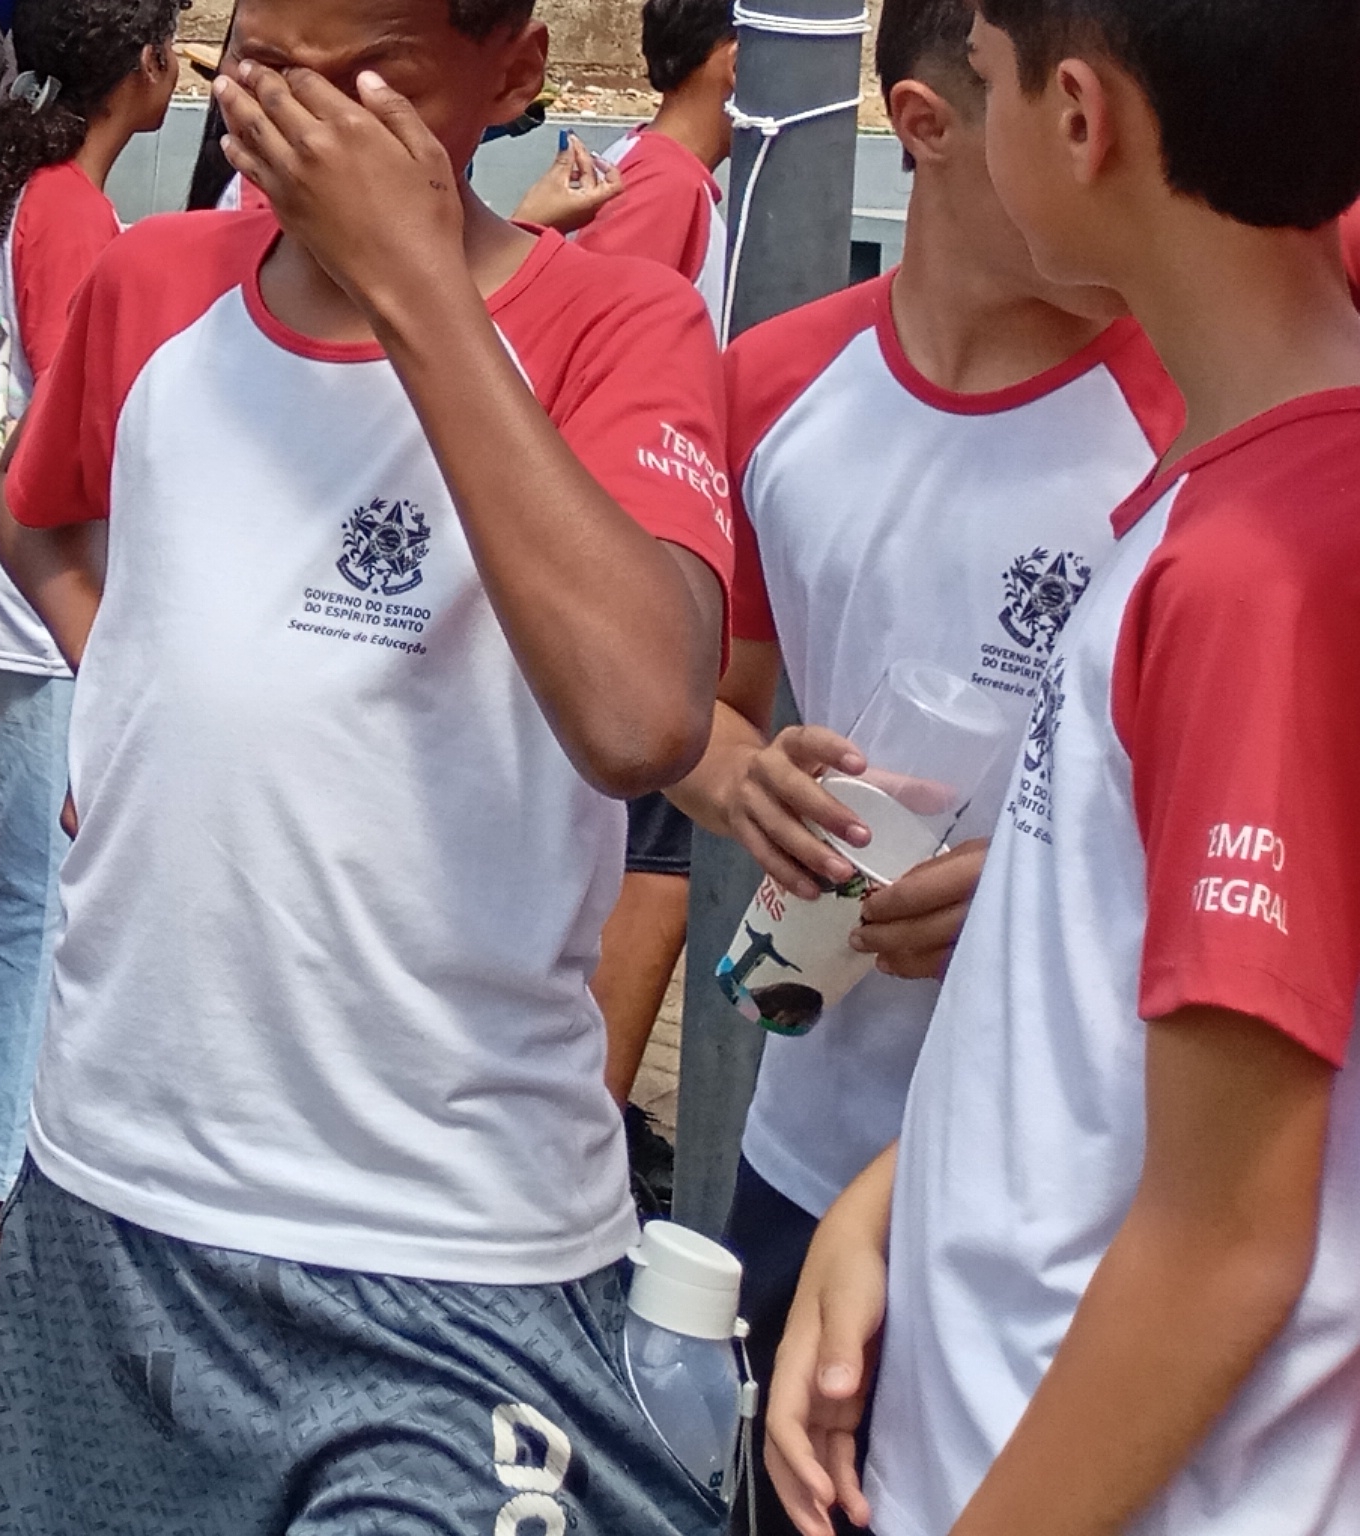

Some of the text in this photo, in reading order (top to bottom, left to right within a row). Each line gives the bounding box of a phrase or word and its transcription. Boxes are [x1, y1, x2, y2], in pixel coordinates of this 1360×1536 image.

[304, 587, 431, 621] GOVERNO DO ESTADO
[304, 601, 424, 634] DO ESPÍRITO SANTO
[287, 619, 427, 655] Secretaria da Educação
[980, 643, 1031, 665] GOVERNO
[981, 656, 998, 669] DO
[971, 672, 1025, 696] Secretaria
